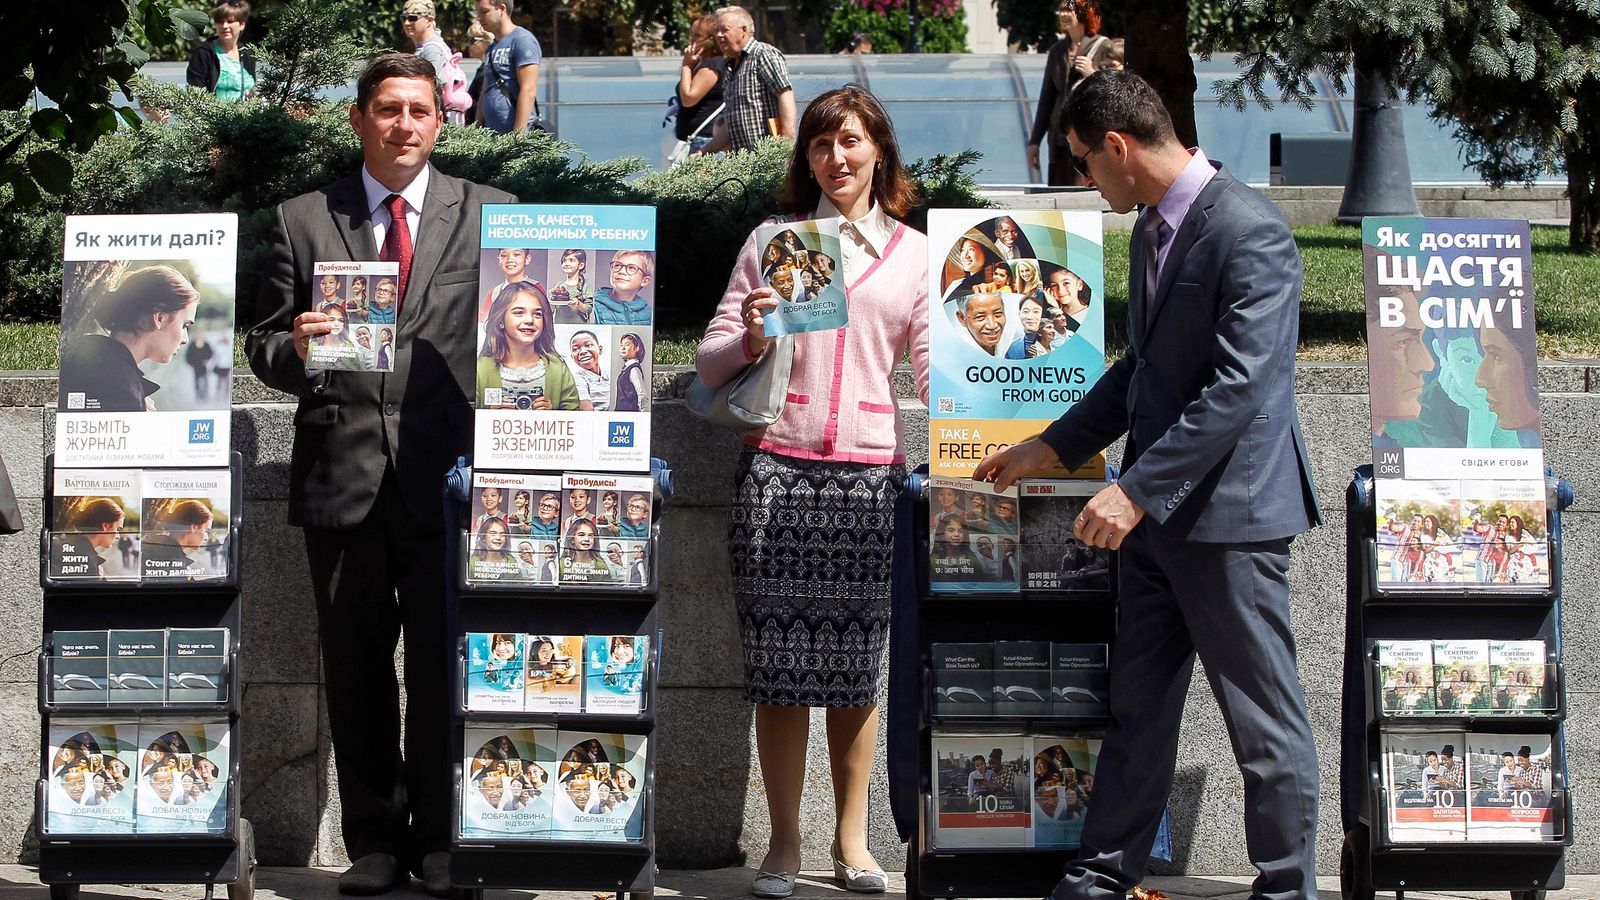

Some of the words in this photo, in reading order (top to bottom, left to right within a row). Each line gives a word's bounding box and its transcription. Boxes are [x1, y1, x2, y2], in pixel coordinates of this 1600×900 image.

[488, 214, 533, 225] ШЕСТЬ
[537, 214, 597, 227] КАЧЕСТВ,
[75, 232, 100, 248] Як
[108, 232, 162, 247] жити
[168, 229, 226, 249] далі?
[487, 227, 587, 241] НЕОБХОДИМЫХ
[591, 228, 648, 241] РЕБЕНКУ
[1376, 226, 1411, 247] Як
[1420, 232, 1521, 252] досягти
[318, 264, 361, 272] Пробудитесь!
[1377, 255, 1524, 291] ЩАСТЯ
[783, 303, 812, 314] ДОБРАЯ
[814, 302, 836, 310] ВЕСТЬ
[1379, 297, 1406, 328] В
[966, 366, 1024, 384] GOOD
[1029, 367, 1086, 384] NEWS
[1002, 388, 1044, 402] FROM
[66, 420, 130, 434] ВІЗЬМІТЬ
[194, 423, 210, 433] JW
[492, 419, 575, 436] ВОЗЬМИТЕ
[613, 425, 630, 436] JW
[192, 433, 210, 441] .ORG
[939, 428, 969, 440] TAKE
[971, 429, 981, 440] A
[66, 437, 127, 450] ЖУРНАЛ
[492, 437, 575, 452] ЭКЗЕМПЛЯР
[939, 443, 982, 460] FREE
[1380, 452, 1399, 464] JW
[1462, 459, 1496, 467] СВІДКИ
[1499, 459, 1529, 467] ЄГОВИ
[1379, 465, 1400, 474] .ORG
[103, 479, 130, 488] БАШТА
[479, 476, 524, 485] Пробудитесь!
[568, 478, 617, 487] Пробудись!
[62, 544, 75, 553] Як
[564, 557, 572, 567] 6
[62, 565, 89, 574] далі?
[169, 568, 205, 576] дальше?
[1028, 572, 1057, 580] 如何面对
[976, 794, 998, 813] 10
[1433, 790, 1454, 808] 10
[1511, 790, 1532, 808] 10
[481, 812, 509, 820] ДОБРА
